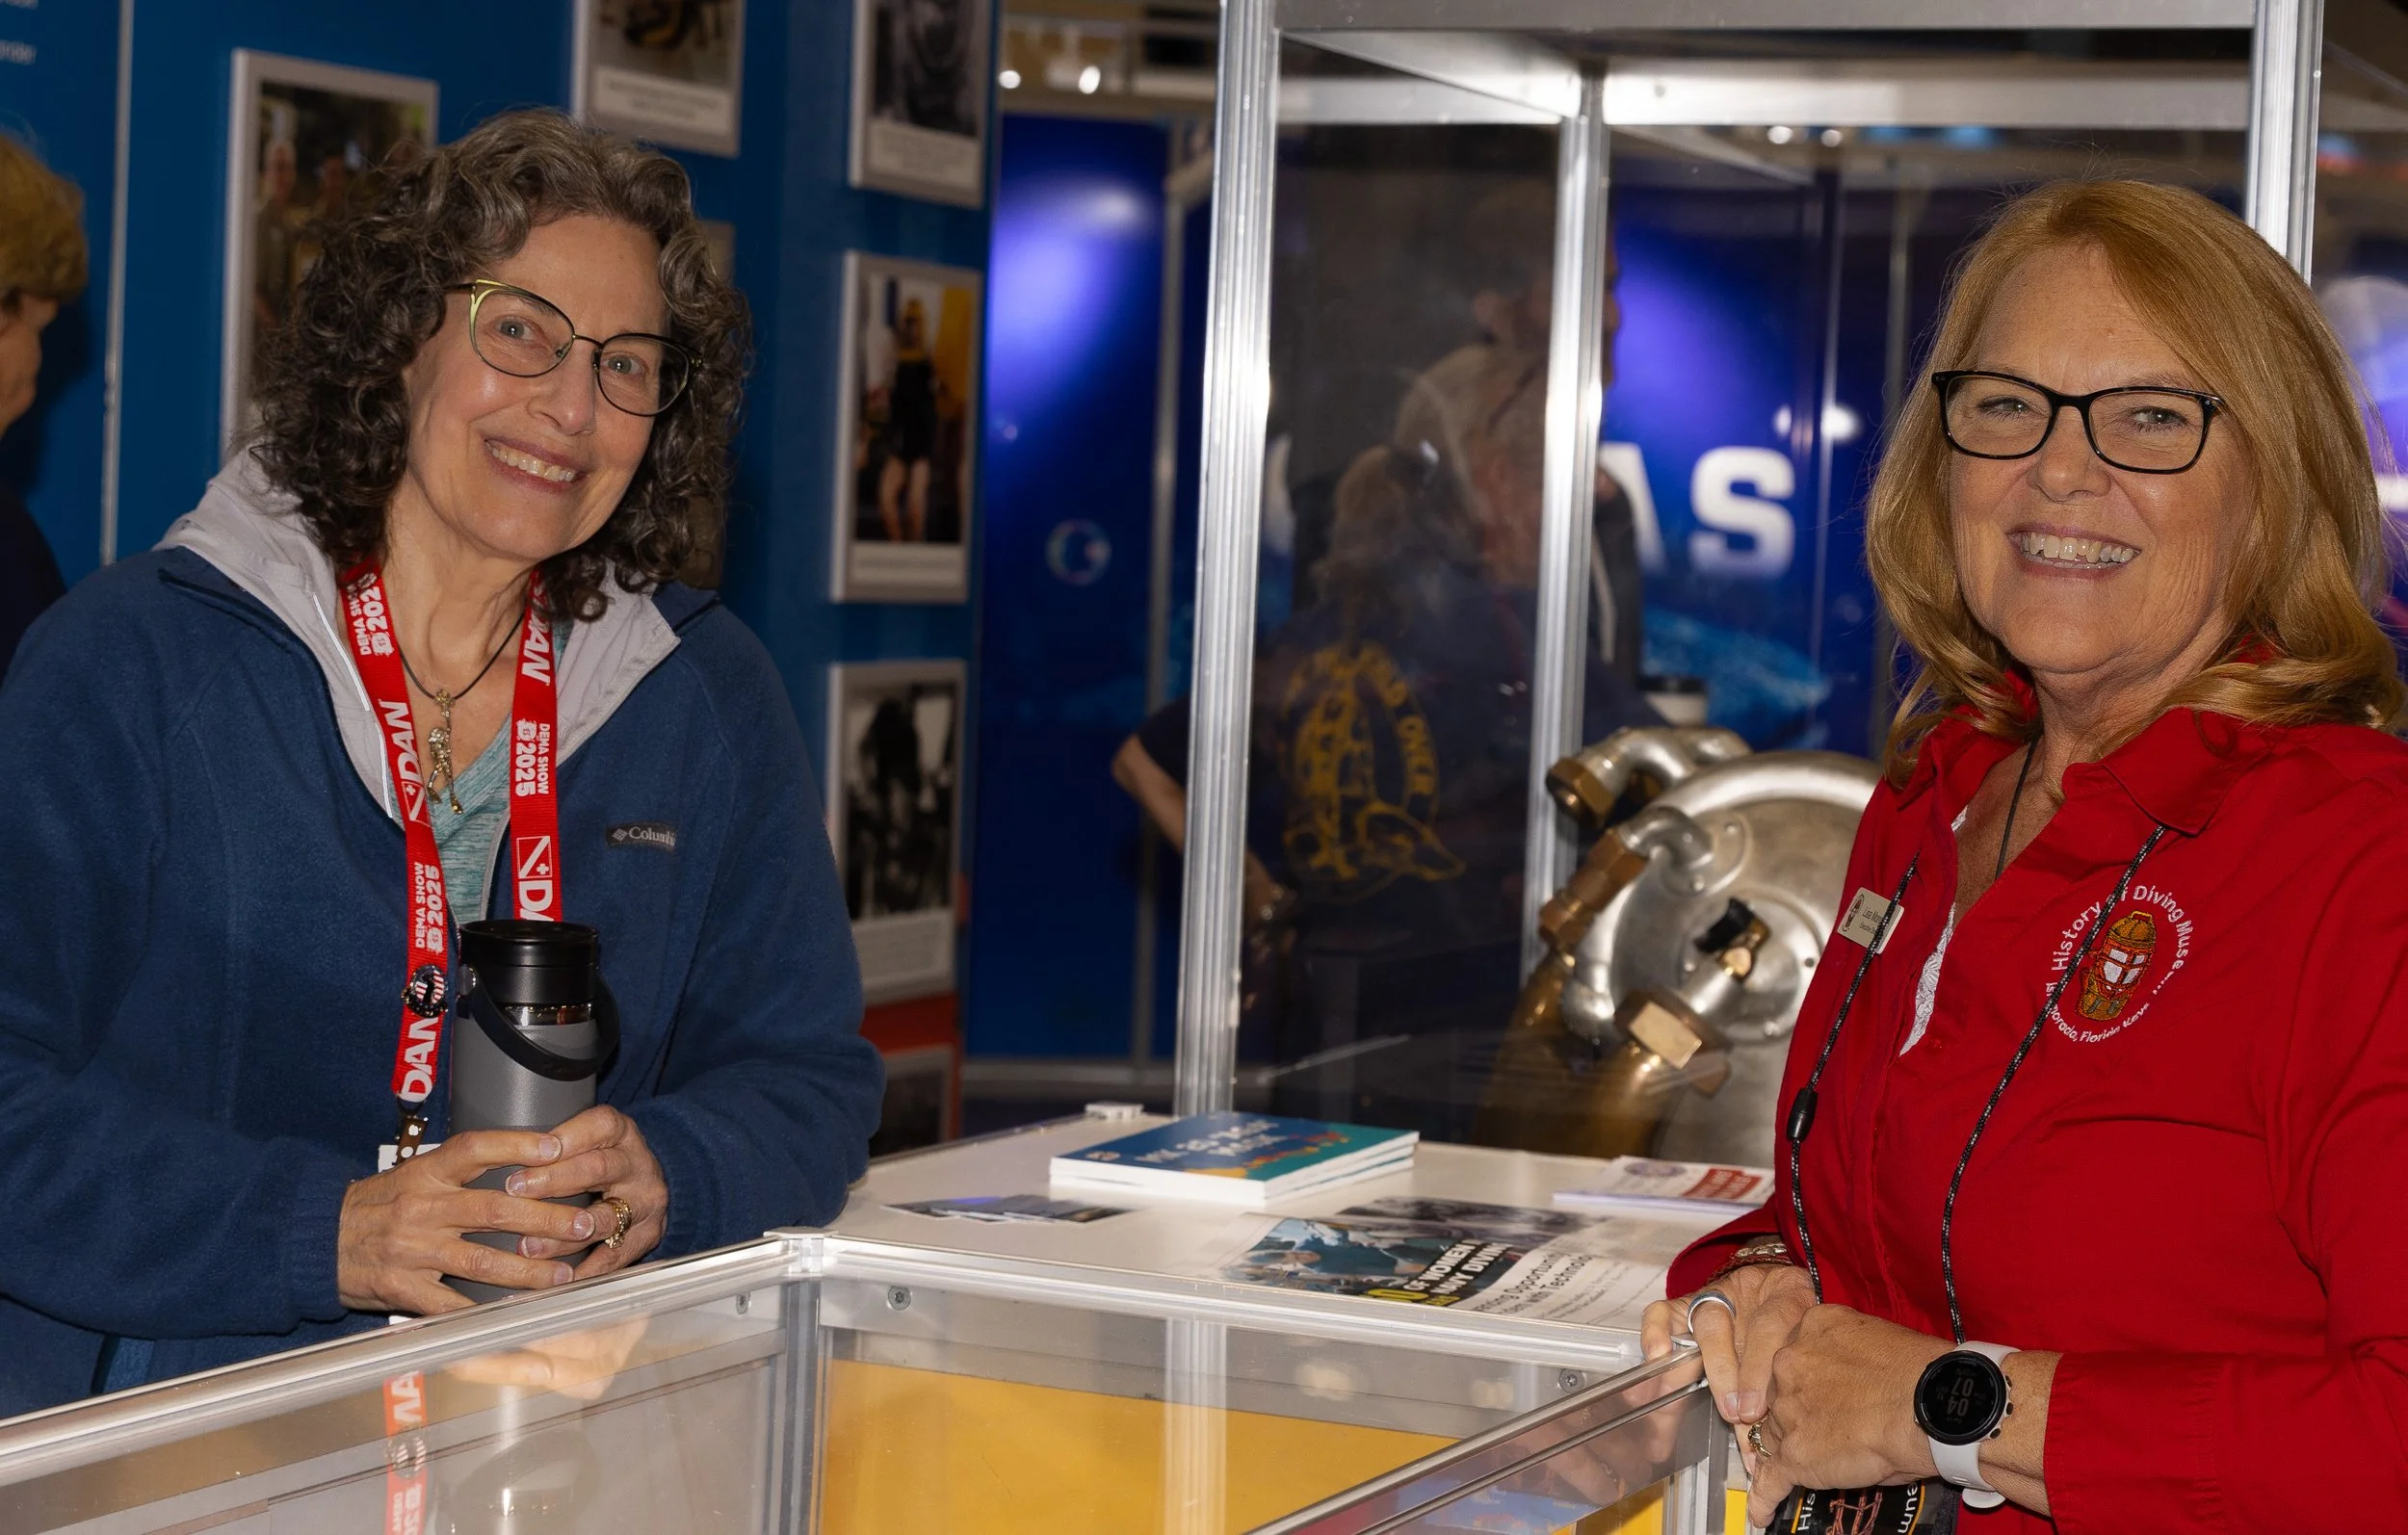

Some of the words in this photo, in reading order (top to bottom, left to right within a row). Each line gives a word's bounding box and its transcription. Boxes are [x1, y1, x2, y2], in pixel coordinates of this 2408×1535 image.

[353, 617, 373, 655] DEMA
[379, 698, 423, 785] DAN
[537, 723, 551, 754] DEMA
[515, 741, 537, 797] 2025
[537, 756, 550, 794] SHOW
[414, 862, 427, 904] SHOW
[425, 865, 444, 926] 2025
[414, 905, 426, 949] DEMA
[2052, 901, 2101, 971] History
[2133, 885, 2185, 923] Diving
[401, 1016, 439, 1103] DAN
[1419, 1243, 1477, 1282] WOMEN
[1946, 1395, 1970, 1418] 04
[1950, 1376, 1975, 1397] 07
